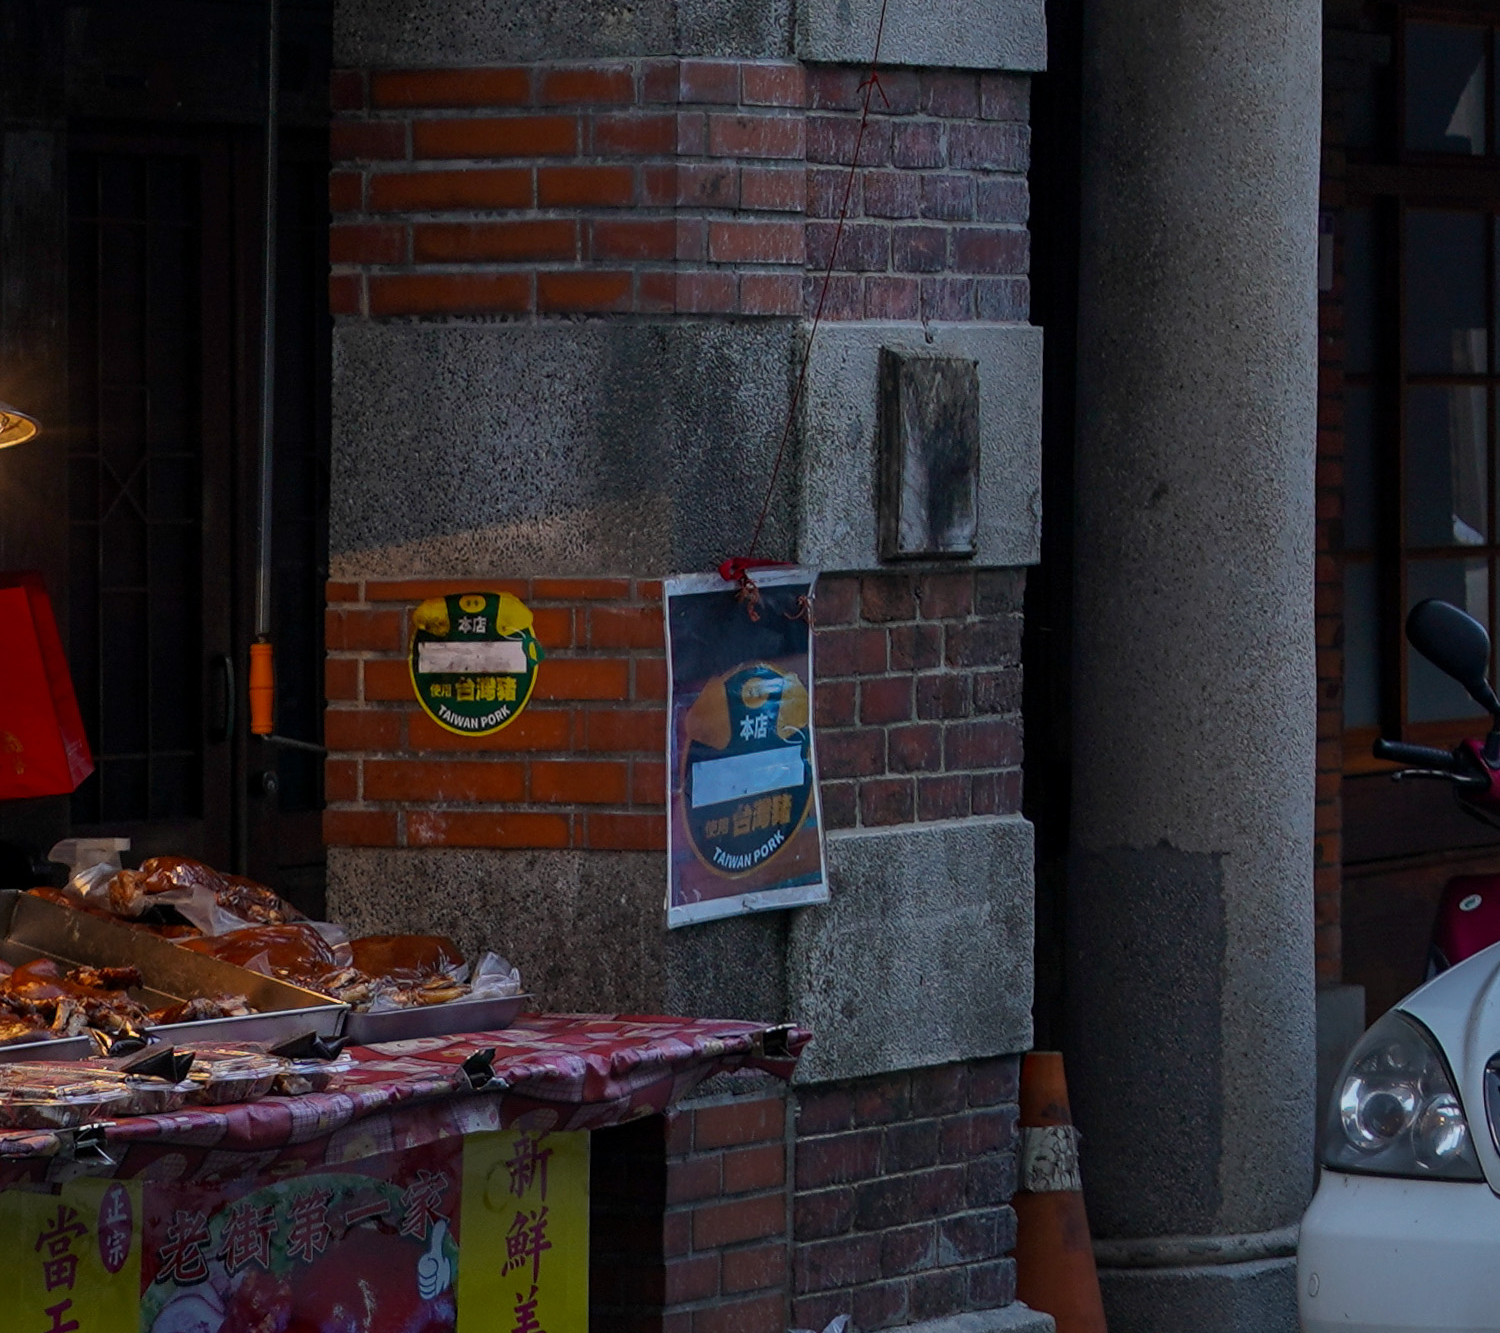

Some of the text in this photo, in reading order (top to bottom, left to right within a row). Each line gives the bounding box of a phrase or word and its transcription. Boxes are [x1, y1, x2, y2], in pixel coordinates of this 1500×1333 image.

[457, 615, 488, 634] 本店
[436, 703, 512, 730] TAIWAN PORK
[739, 712, 770, 742] 本店
[712, 829, 786, 870] TAIWAN PORK
[103, 1184, 130, 1259] 正宗
[154, 1169, 449, 1286] 老街第一家
